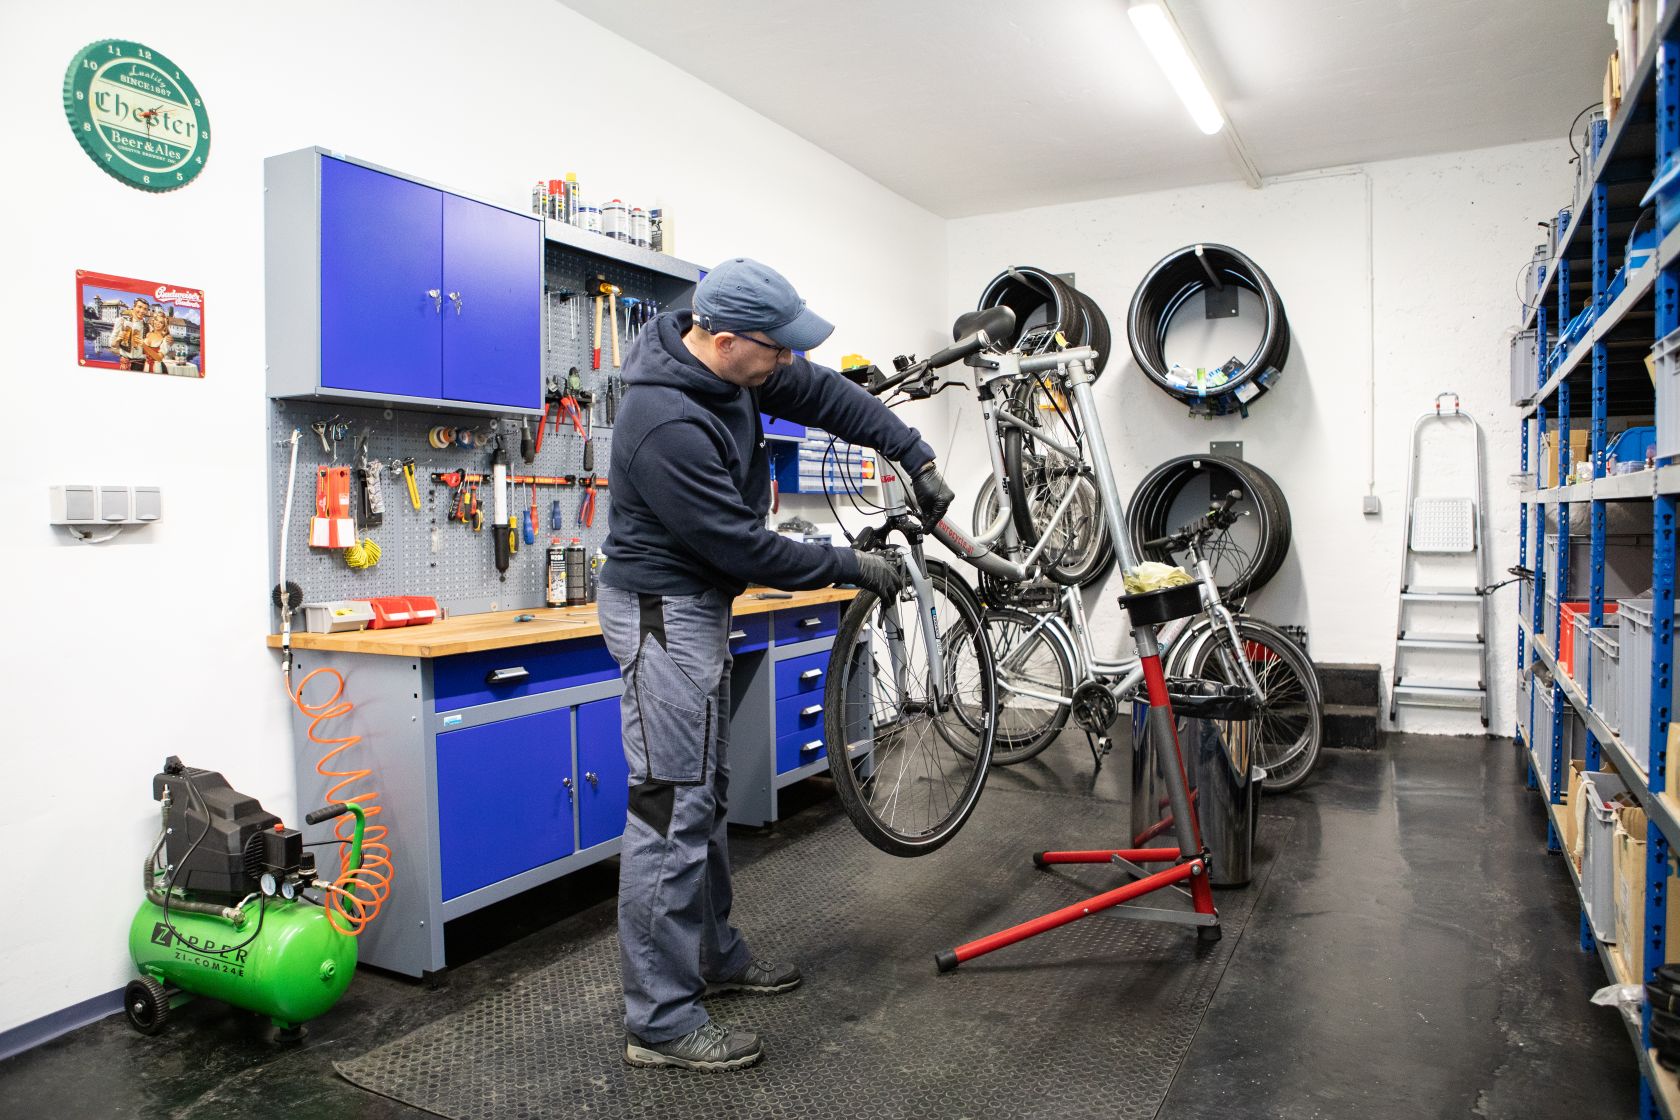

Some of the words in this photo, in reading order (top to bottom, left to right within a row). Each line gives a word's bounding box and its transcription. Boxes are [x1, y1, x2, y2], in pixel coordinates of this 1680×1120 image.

[108, 45, 122, 57] 11
[138, 48, 152, 60] 12
[83, 59, 98, 71] 10
[175, 71, 181, 80] 1
[76, 91, 84, 100] 9
[194, 98, 201, 107] 2
[94, 91, 196, 138] Chester
[83, 122, 92, 132] 8
[202, 130, 209, 139] 3
[104, 152, 113, 163] 7
[195, 156, 202, 165] 4
[143, 175, 150, 184] 6
[176, 172, 184, 182] 5
[151, 922, 248, 964] ZIPPER
[175, 952, 245, 977] ZI-COM24E
